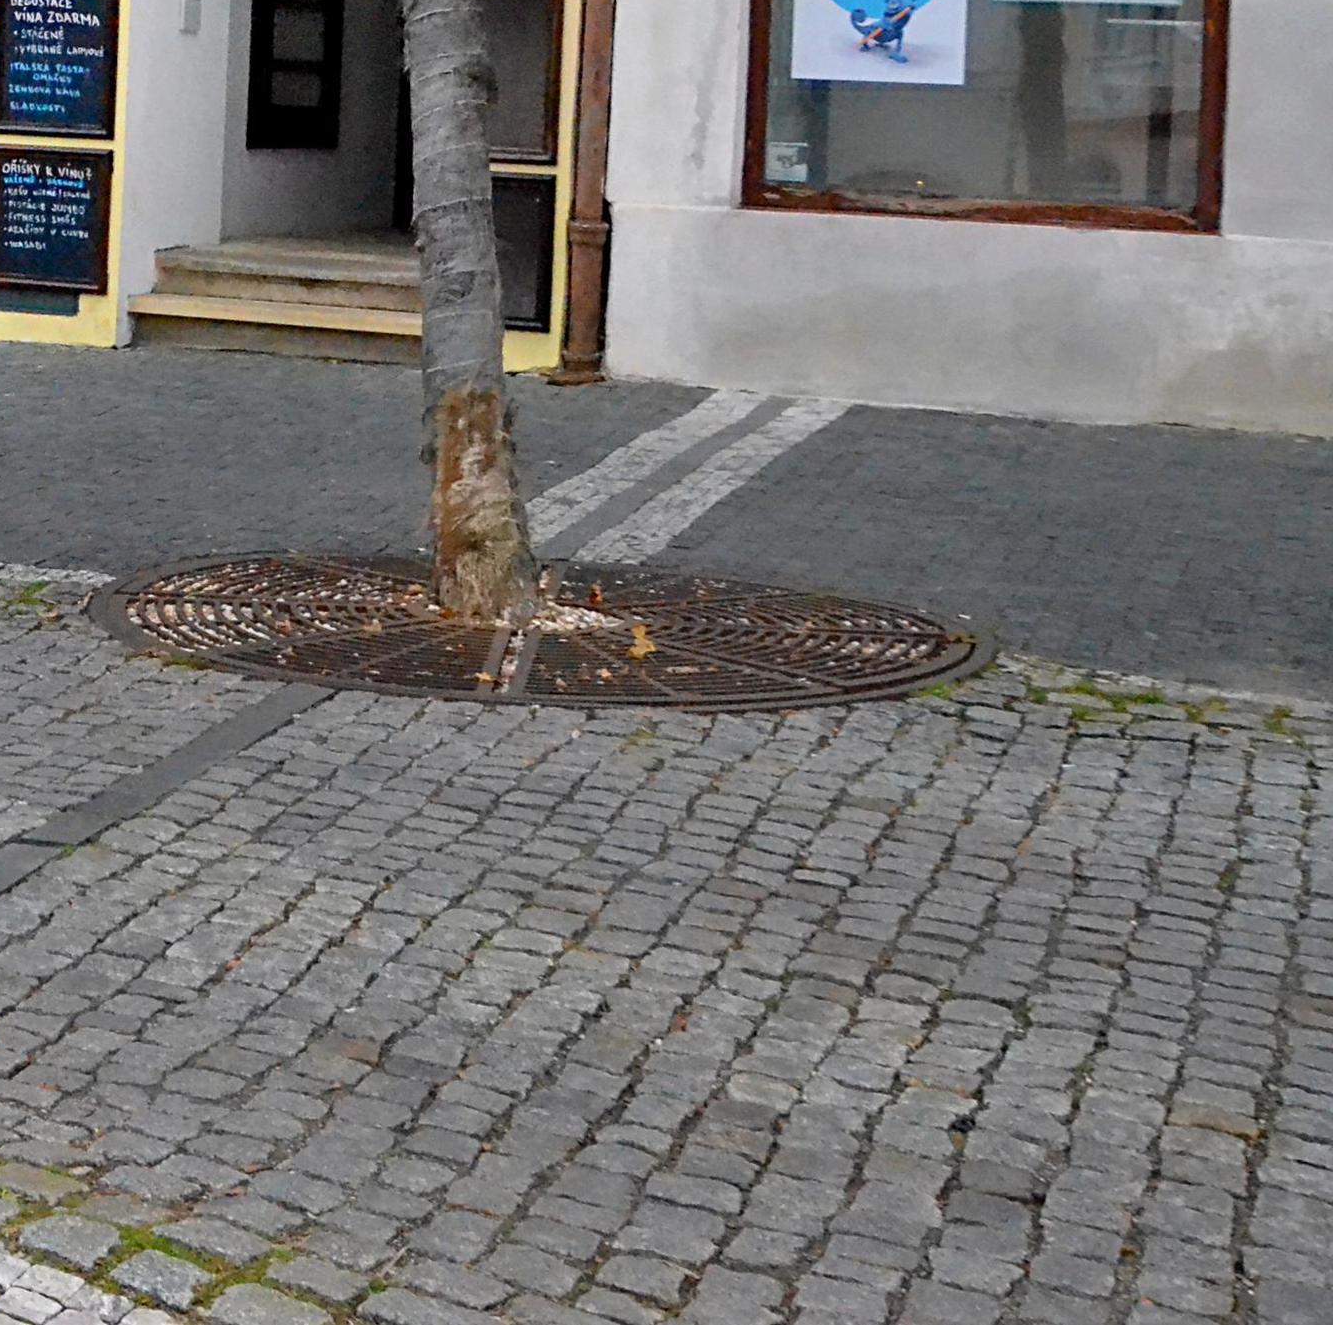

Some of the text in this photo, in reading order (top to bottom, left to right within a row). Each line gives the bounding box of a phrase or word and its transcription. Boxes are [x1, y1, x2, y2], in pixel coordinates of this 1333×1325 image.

[14, 7, 101, 27] VÍNA ZDARMA
[2, 159, 40, 175] OŘÍŠKY
[45, 165, 53, 176] K
[8, 211, 47, 223] FITNESS
